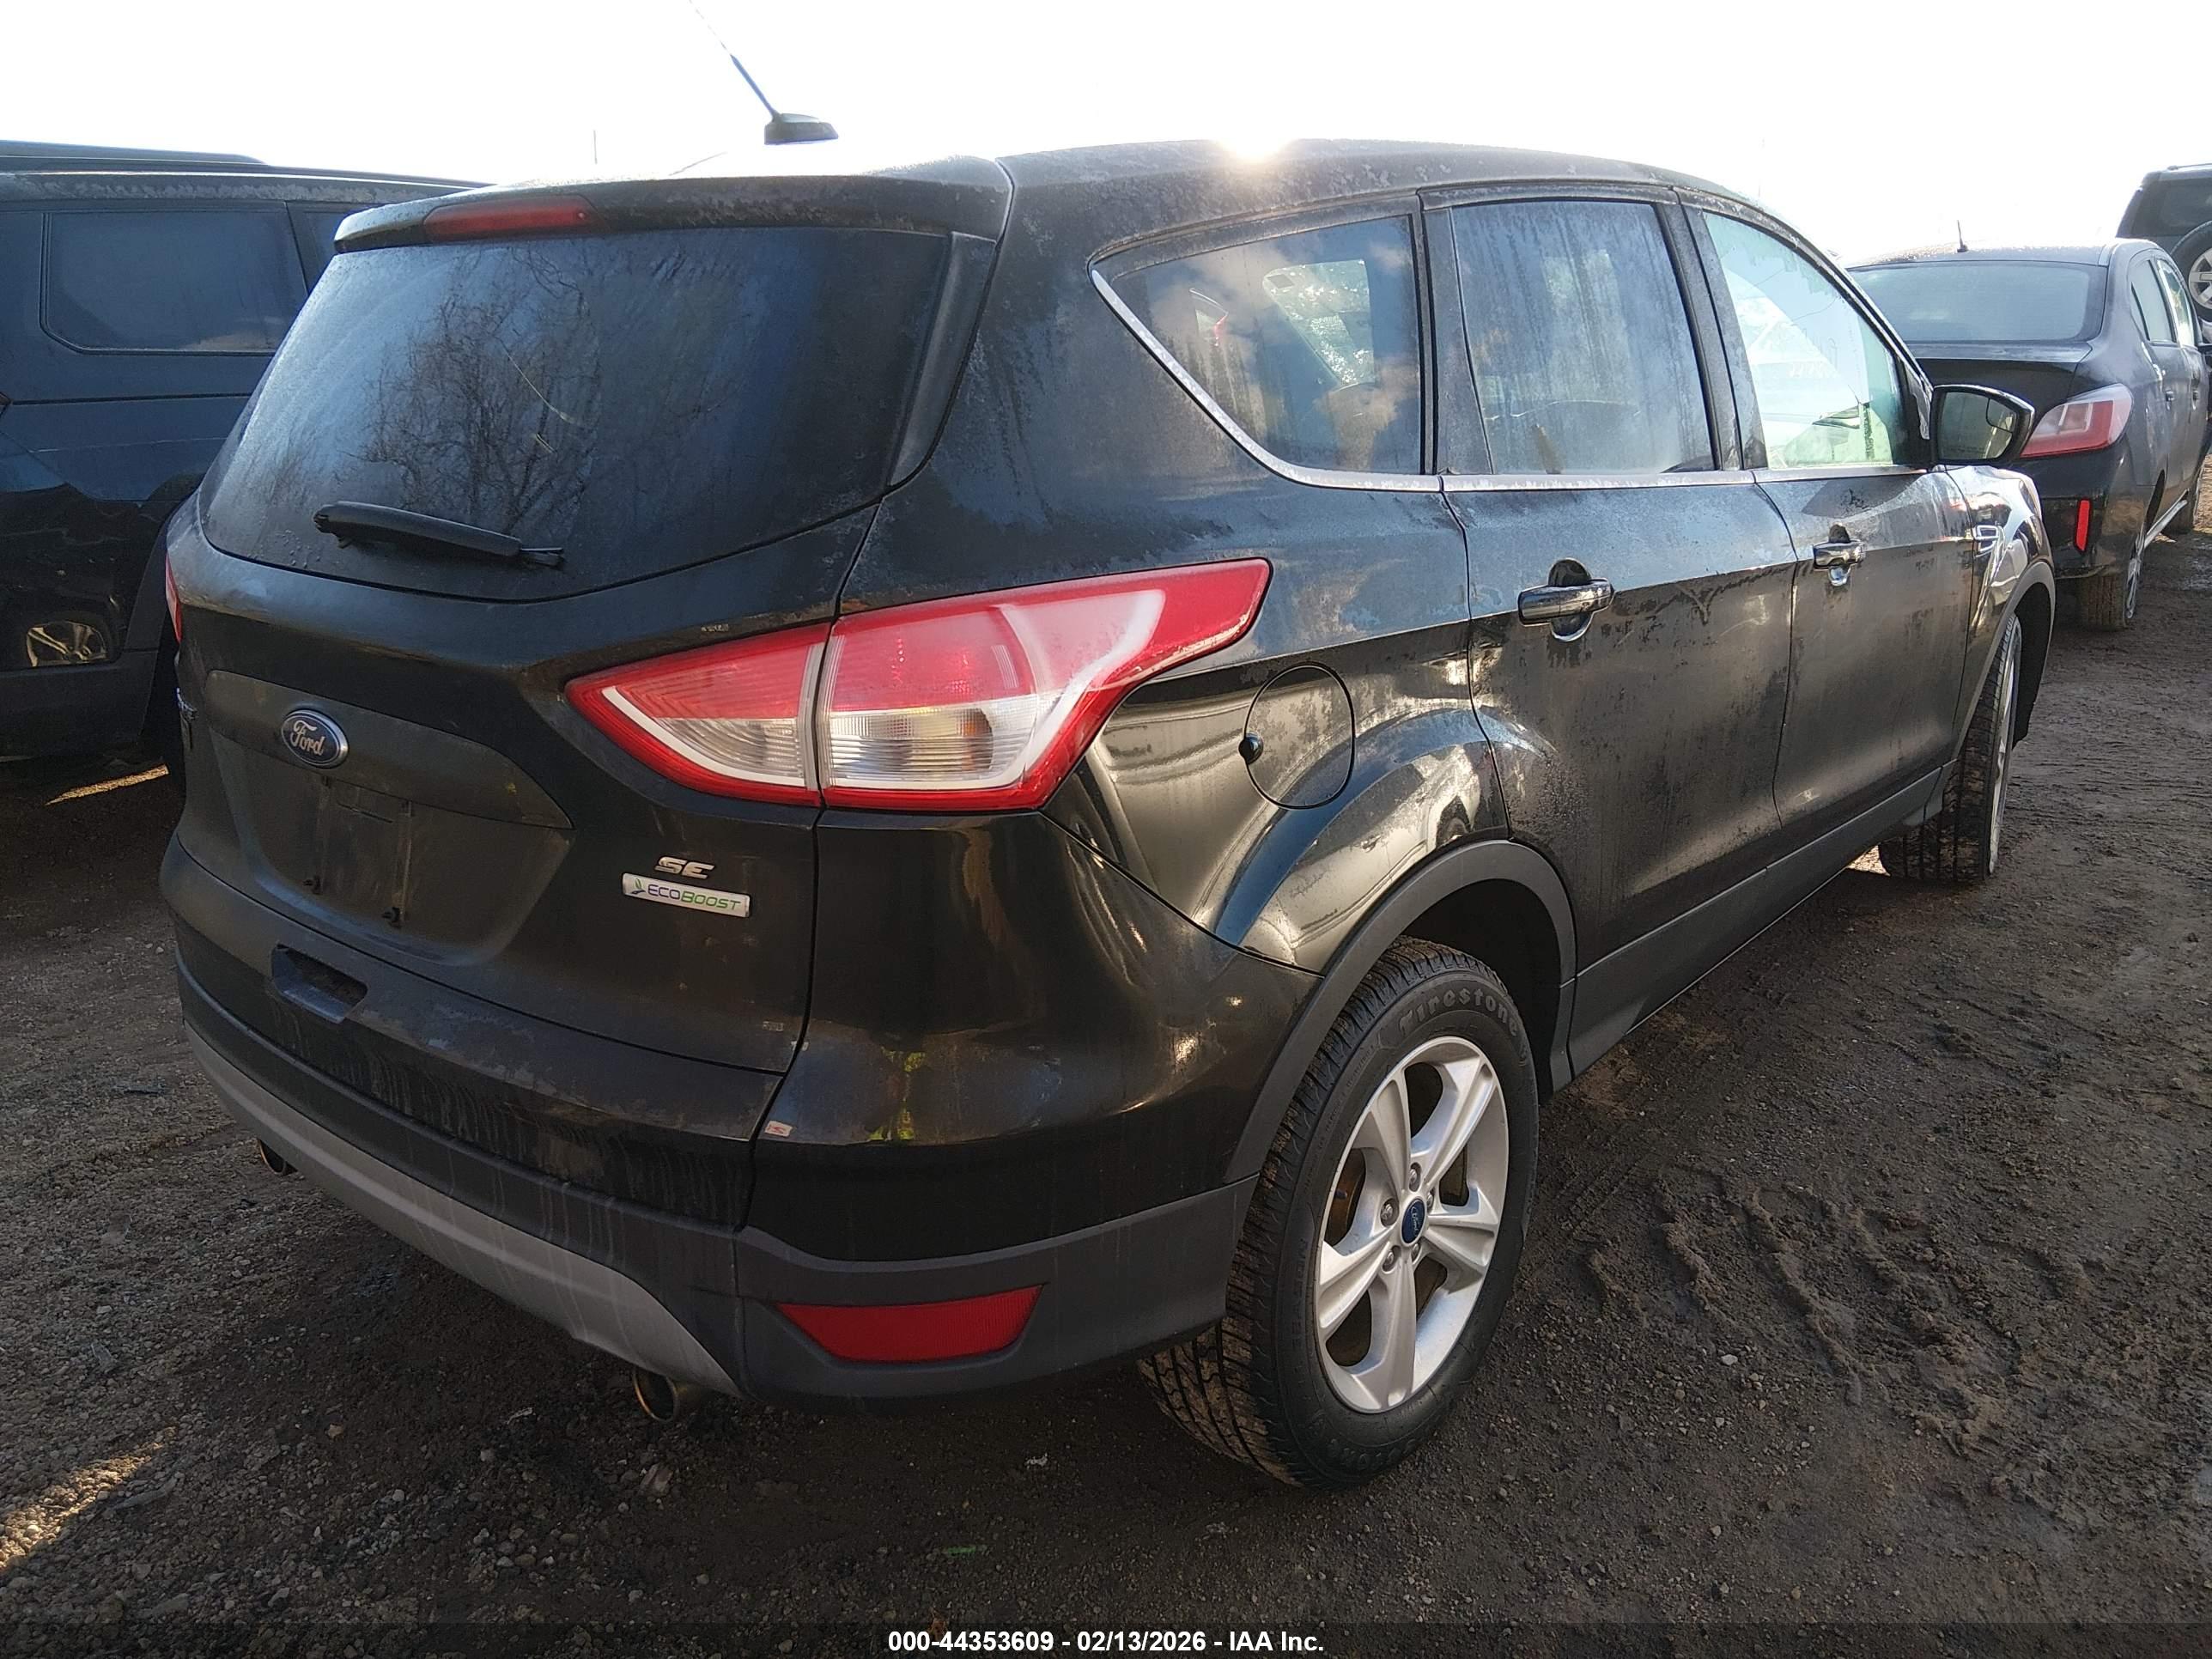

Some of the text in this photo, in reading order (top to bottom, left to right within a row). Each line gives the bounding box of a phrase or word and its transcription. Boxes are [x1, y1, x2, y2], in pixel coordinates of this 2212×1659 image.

[290, 720, 325, 756] Ford
[654, 856, 714, 879] SE
[647, 884, 741, 910] ECOBOOST
[1399, 988, 1518, 1036] Firestone
